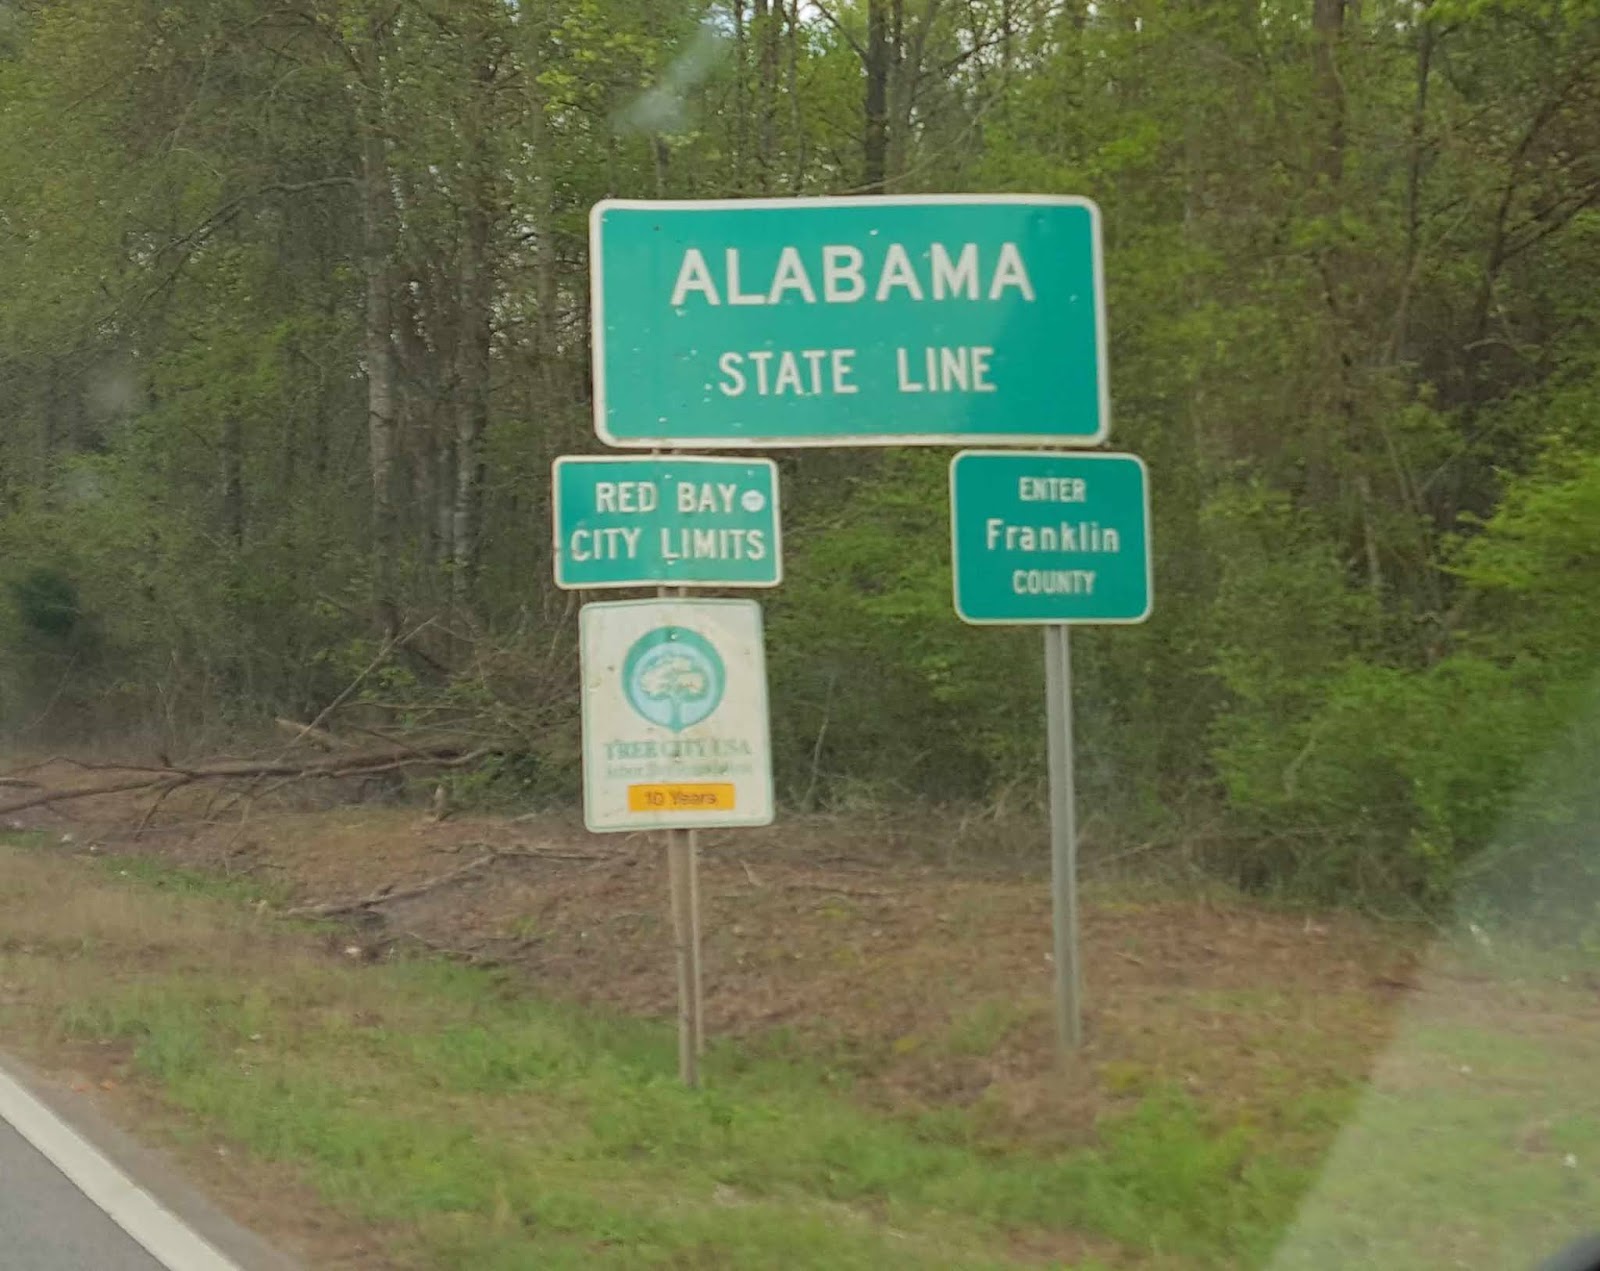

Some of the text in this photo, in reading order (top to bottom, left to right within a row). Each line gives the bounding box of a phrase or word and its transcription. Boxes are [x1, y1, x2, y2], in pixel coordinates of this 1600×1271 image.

[671, 242, 1035, 306] ALABAMA
[718, 347, 997, 397] STATE LINE
[595, 482, 737, 513] RED BAY
[1019, 476, 1086, 502] ENTER
[571, 527, 765, 562] CITY LIMITS
[986, 518, 1120, 553] Franklin
[1013, 569, 1096, 595] COUNTY
[644, 789, 718, 806] 10 Years
